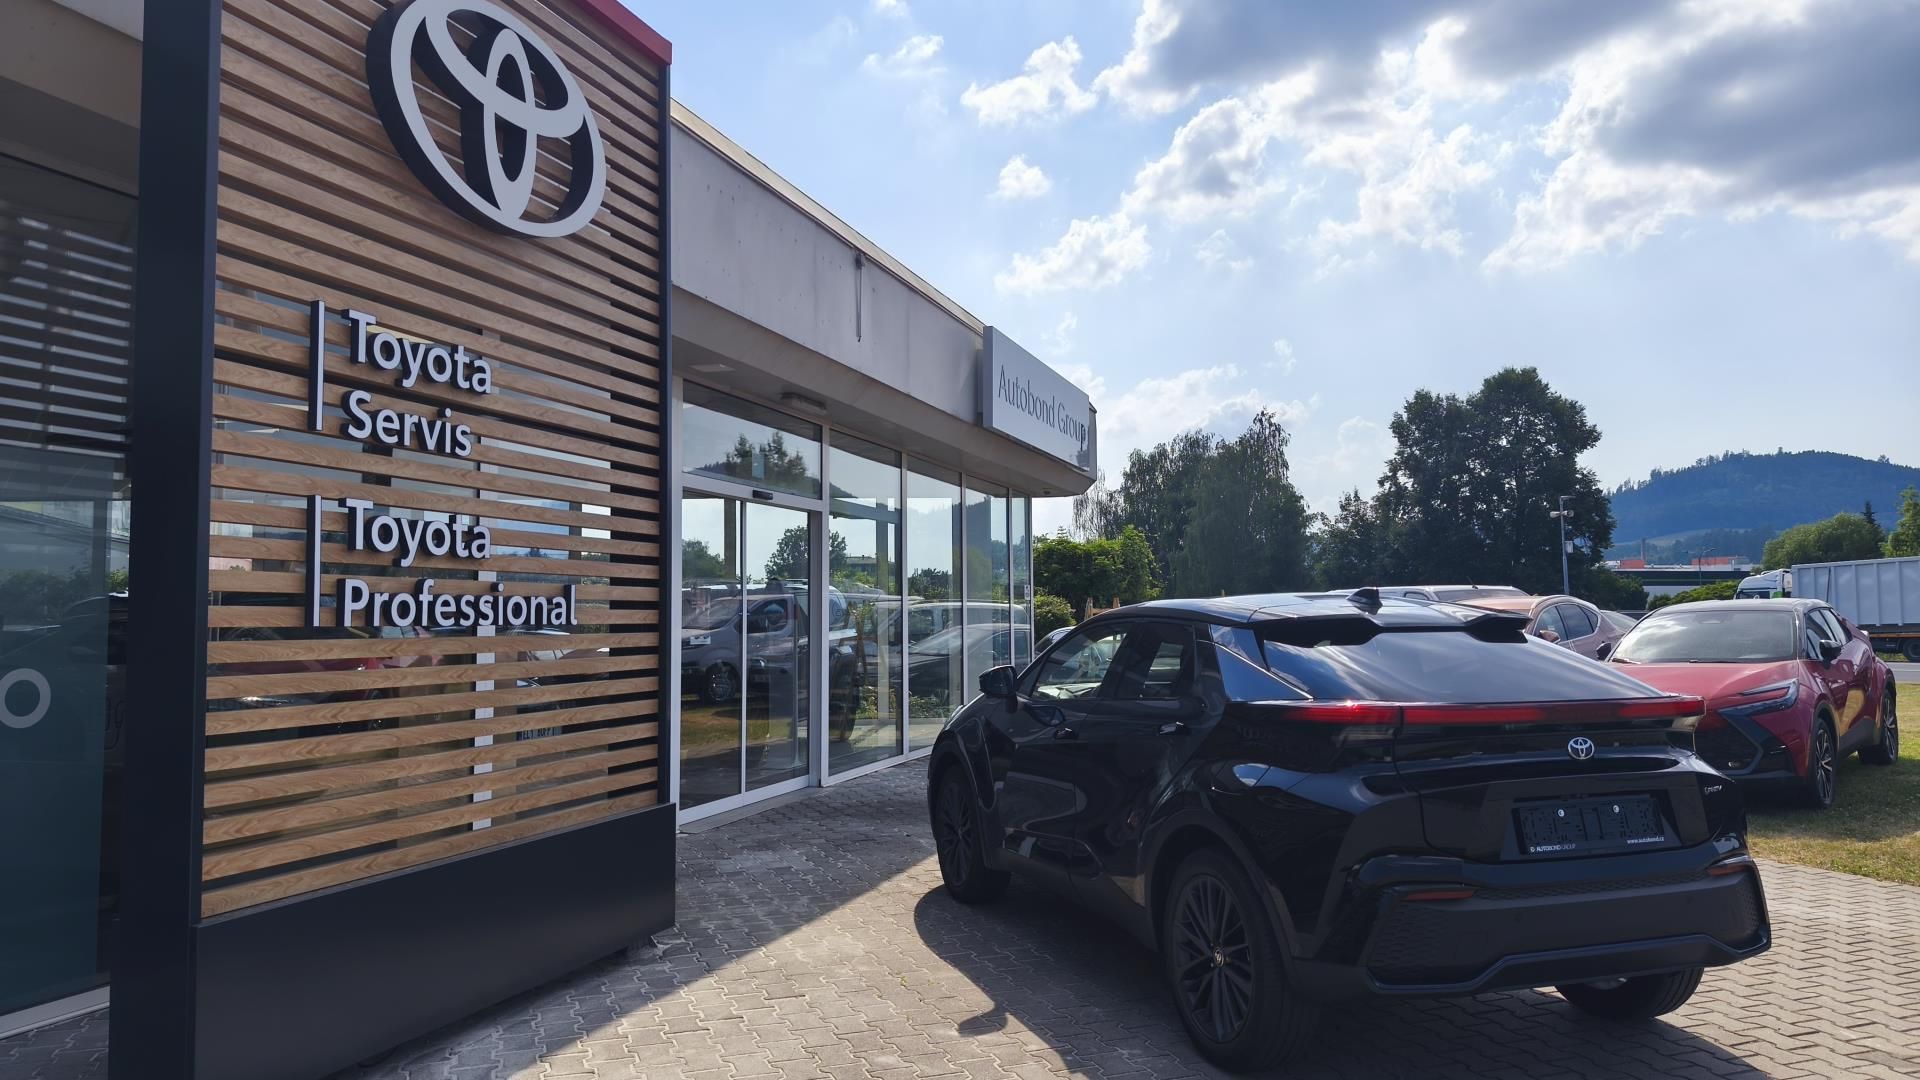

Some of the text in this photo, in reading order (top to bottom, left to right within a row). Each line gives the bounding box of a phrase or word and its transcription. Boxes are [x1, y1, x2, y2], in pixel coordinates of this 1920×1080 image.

[346, 309, 492, 394] Toyota
[345, 389, 472, 457] Servis
[998, 363, 1087, 453] Autobond Group
[343, 497, 491, 568] Toyota
[341, 578, 578, 627] Professional
